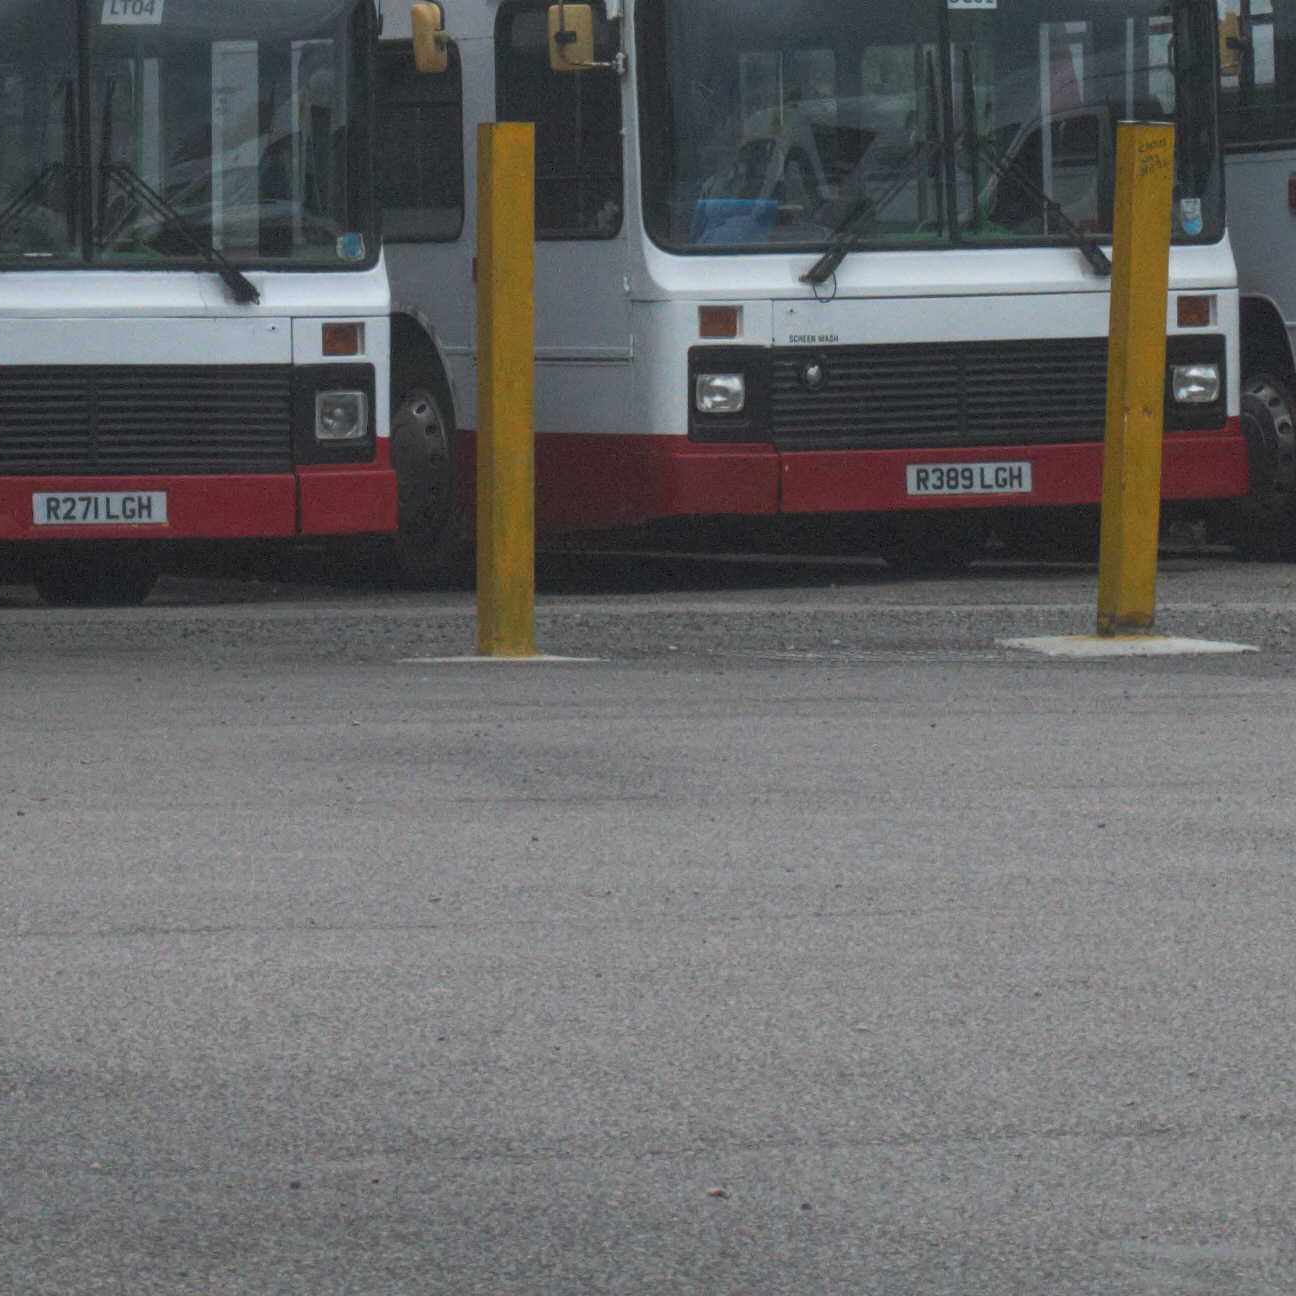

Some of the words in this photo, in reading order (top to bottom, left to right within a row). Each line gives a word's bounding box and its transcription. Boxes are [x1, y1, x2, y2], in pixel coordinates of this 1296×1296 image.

[916, 467, 975, 491] R389
[980, 467, 1023, 489] LGH
[46, 496, 99, 520] R271
[105, 495, 152, 519] LGH
